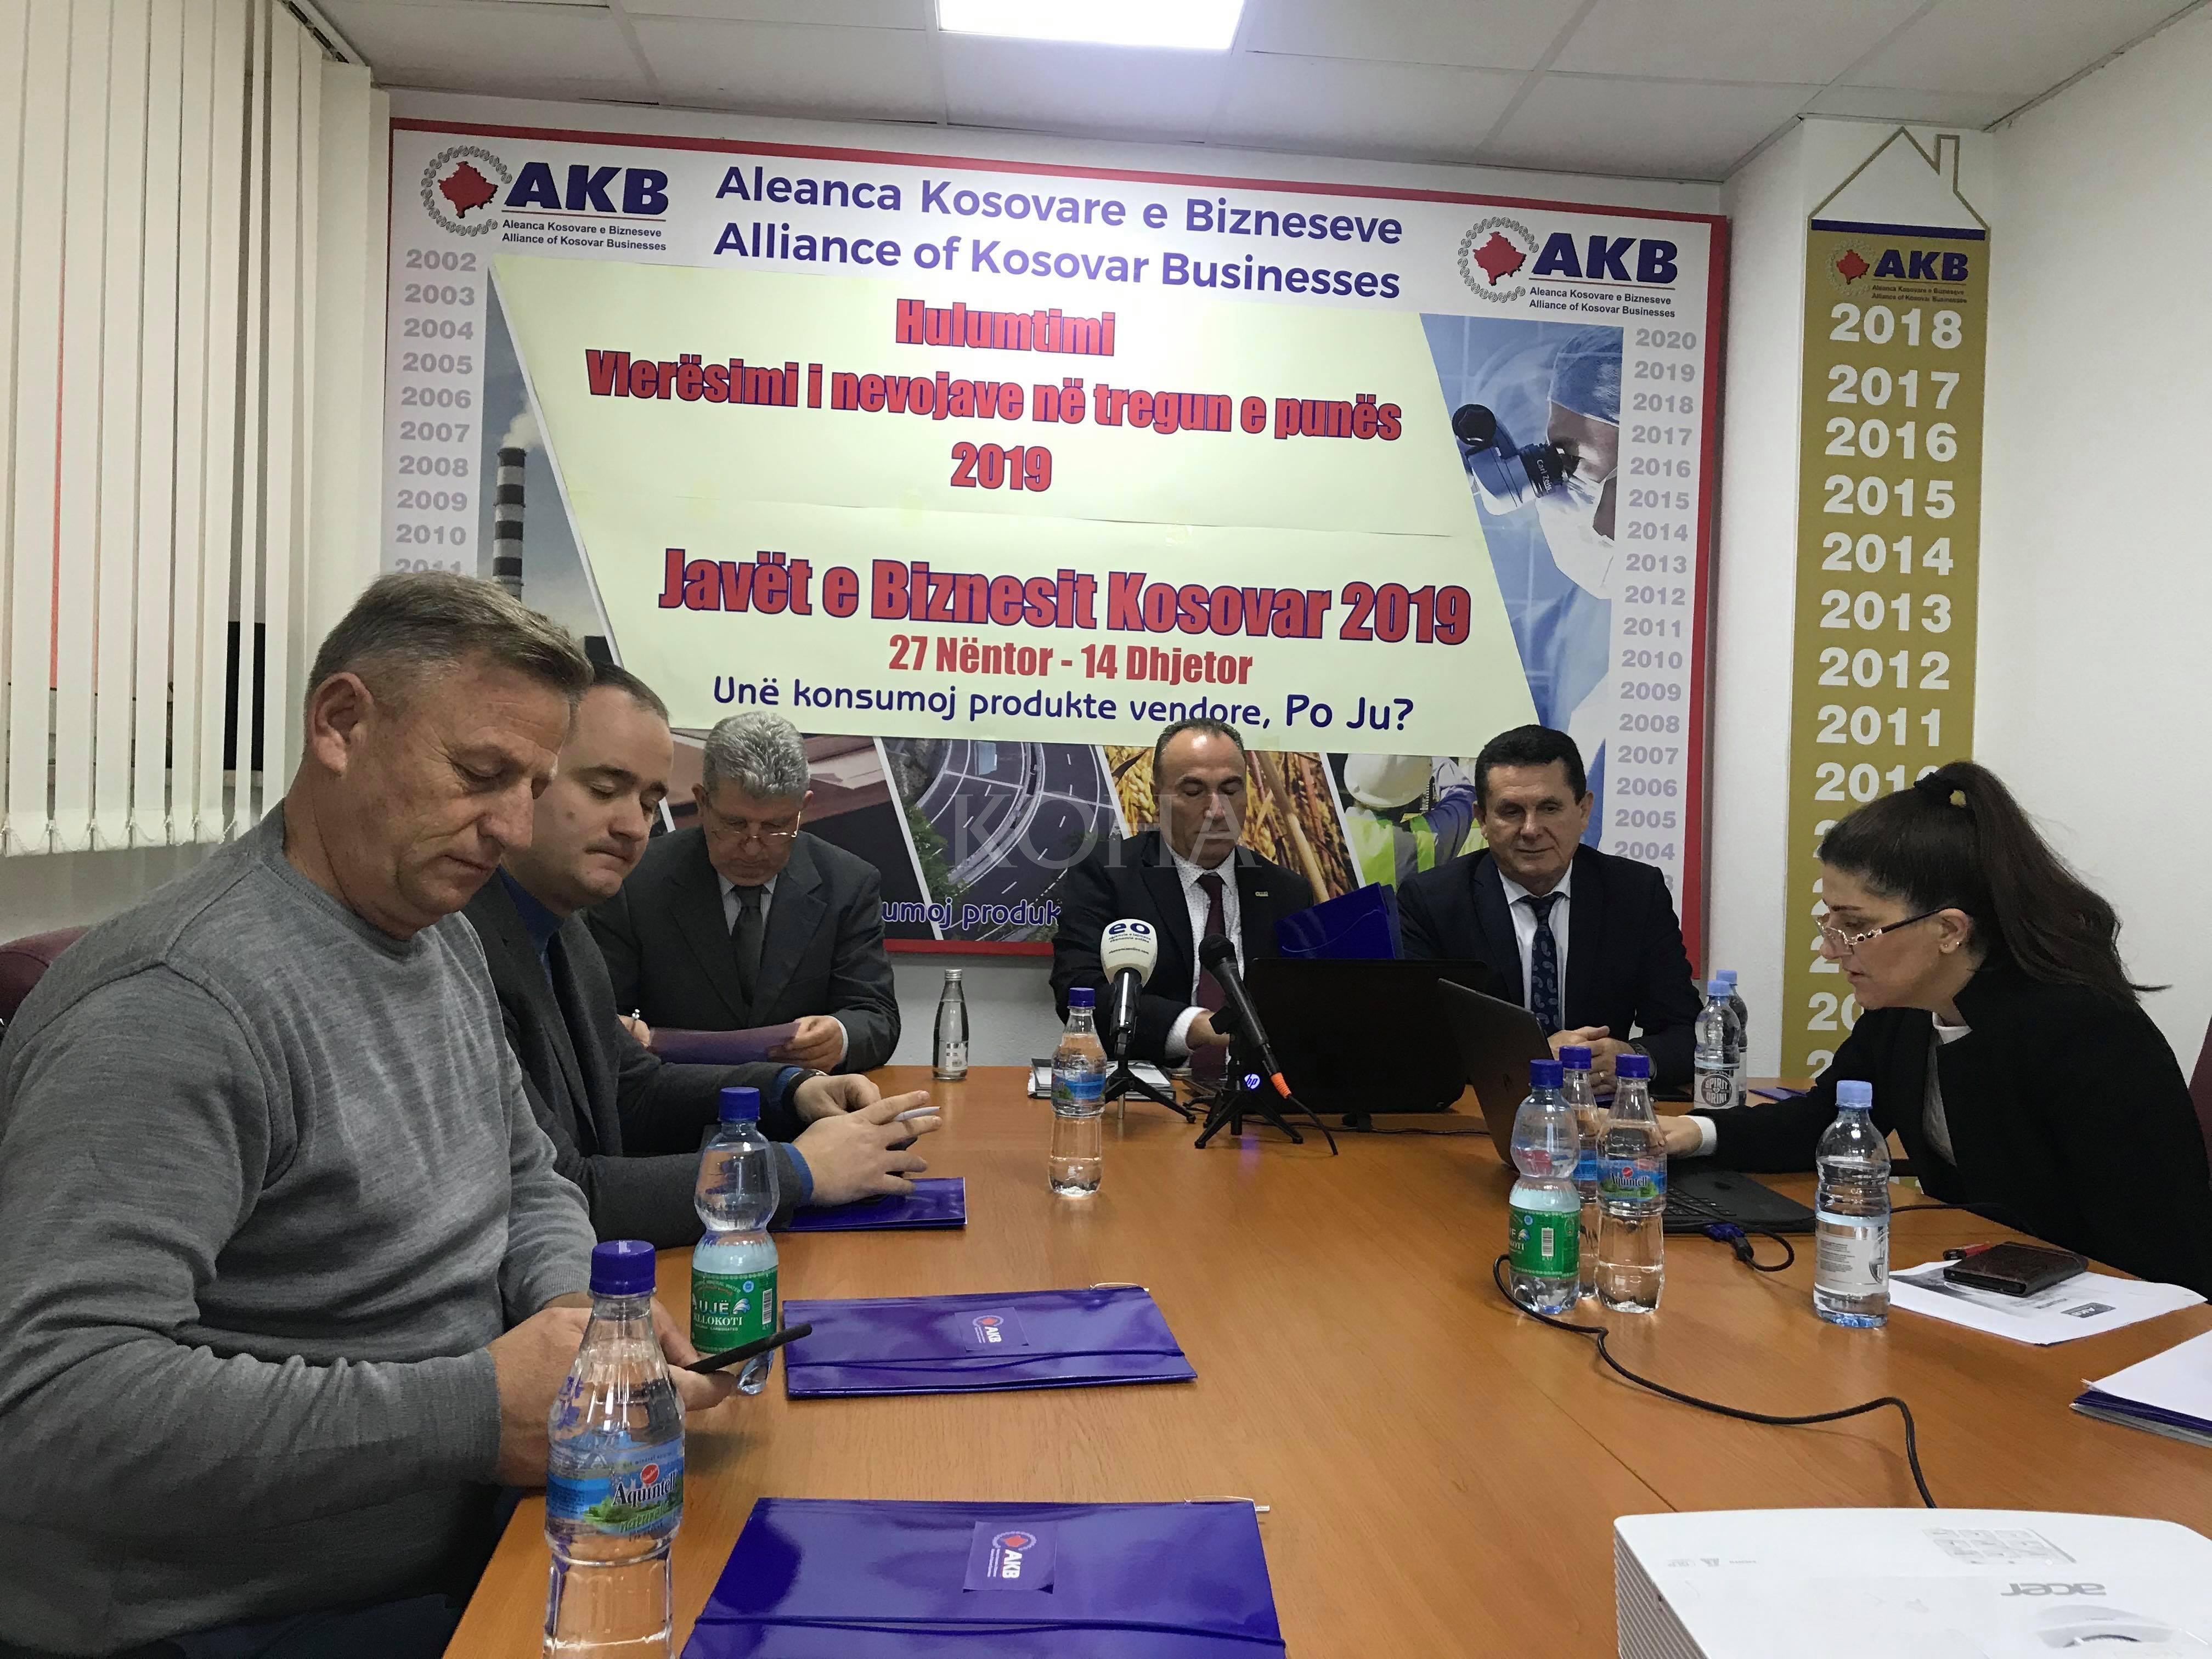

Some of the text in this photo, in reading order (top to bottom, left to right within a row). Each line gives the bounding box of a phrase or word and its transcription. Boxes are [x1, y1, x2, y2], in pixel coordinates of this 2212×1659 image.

[503, 161, 669, 215] AKB
[715, 166, 1402, 245] Aleanca Kosovare e Bizneseve
[502, 219, 544, 231] Aleanca
[548, 222, 596, 233] Kosovare
[609, 225, 662, 237] Bizneseve
[501, 233, 667, 251] Alliance of Kosovar Businesses
[406, 249, 477, 272] 2002
[713, 222, 1400, 299] Alliance of Kosovar Businesses
[1531, 232, 1678, 284] AKB
[1872, 249, 1969, 282] AKB
[405, 283, 475, 306] 2003
[1530, 286, 1567, 298] Aleanca
[1570, 289, 1614, 301] Kosovare
[1624, 293, 1671, 306] Bizneseve
[1529, 299, 1675, 318] Alliance of Kosovar Businesses
[403, 317, 473, 341] 2004
[895, 298, 1116, 357] Hulumtimi
[1829, 302, 1962, 349] 2018
[1635, 328, 1697, 350] 2020
[402, 352, 473, 375] 2005
[1634, 360, 1695, 382] 2019
[401, 386, 472, 409] 2006
[585, 349, 1402, 441] Vlerësimi i nevojave në tregun e punës
[1827, 364, 1960, 409] 2017
[1633, 393, 1694, 414] 2018
[400, 420, 470, 443] 2007
[1631, 425, 1692, 445] 2017
[1825, 417, 1957, 462] 2016
[398, 455, 469, 478] 2008
[950, 441, 1052, 492] 2019
[1536, 459, 1553, 491] Carl Zeiss
[1630, 456, 1691, 478] 2016
[397, 489, 468, 512] 2009
[1628, 489, 1690, 510] 2015
[1822, 474, 1955, 519] 2015
[396, 523, 466, 546] 2010
[1627, 521, 1688, 541] 2014
[1626, 553, 1687, 574] 2013
[1821, 532, 1954, 575] 2014
[658, 548, 1472, 646] Javët e Biznesit Kosovar 2019
[1624, 585, 1685, 606] 2012
[1819, 589, 1951, 633] 2013
[1623, 617, 1681, 638] 2011
[888, 634, 928, 672] 27
[936, 636, 1054, 676] Nëntor
[1080, 644, 1118, 679] 14
[1126, 645, 1254, 686] Dhjetor
[1621, 649, 1683, 670] 2010
[1818, 646, 1950, 690] 2012
[714, 675, 1414, 731] Unë konsumoj produkte vendore, Po Ju?
[1620, 681, 1681, 702] 2009
[1619, 713, 1680, 733] 2008
[1816, 704, 1940, 747] 2011
[1617, 745, 1679, 765] 2007
[1616, 777, 1678, 797] 2006
[1615, 809, 1676, 829] 2005
[1615, 840, 1675, 861] 2004
[1108, 923, 1150, 935] eo
[1244, 1074, 1260, 1089] hp
[699, 1300, 729, 1316] UJË
[611, 1469, 678, 1508] Aquintell
[1002, 1548, 1023, 1579] AKB
[2001, 1583, 2107, 1596] acer
